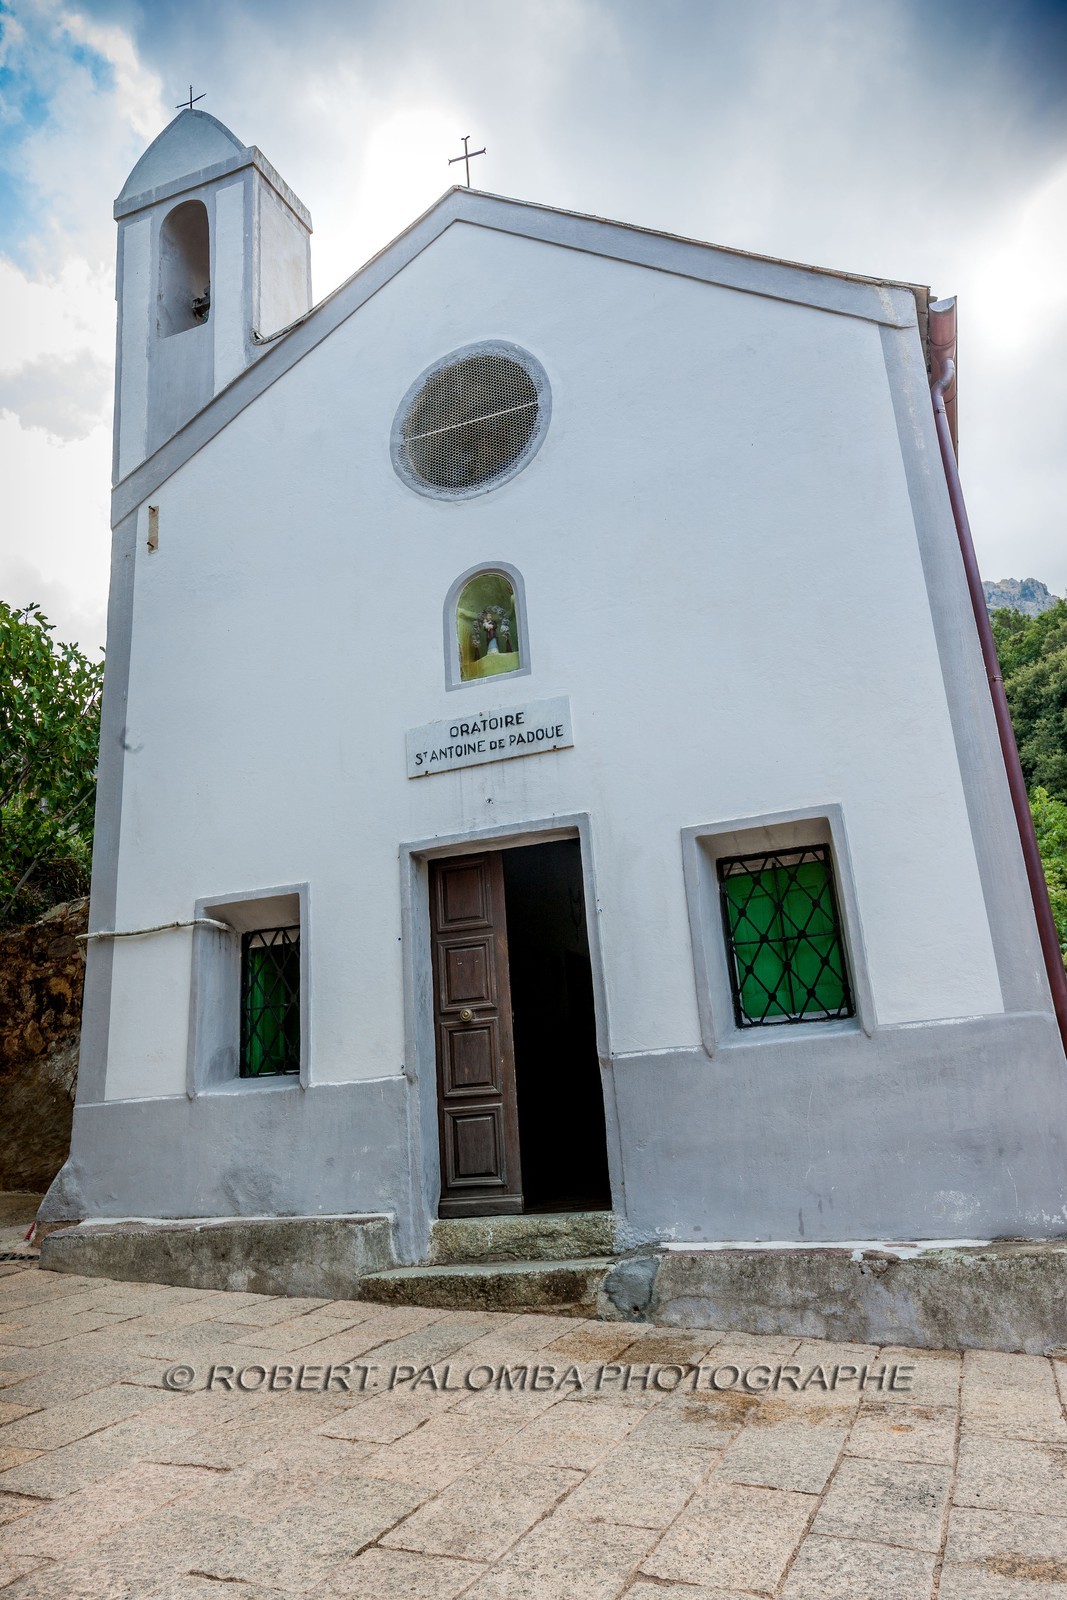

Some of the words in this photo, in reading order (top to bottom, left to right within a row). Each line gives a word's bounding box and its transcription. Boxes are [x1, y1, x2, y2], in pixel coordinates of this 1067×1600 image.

[450, 712, 525, 738] ORATOIRE
[429, 740, 486, 763] ANTOINE
[489, 739, 505, 751] DE
[509, 724, 564, 746] PADOUE
